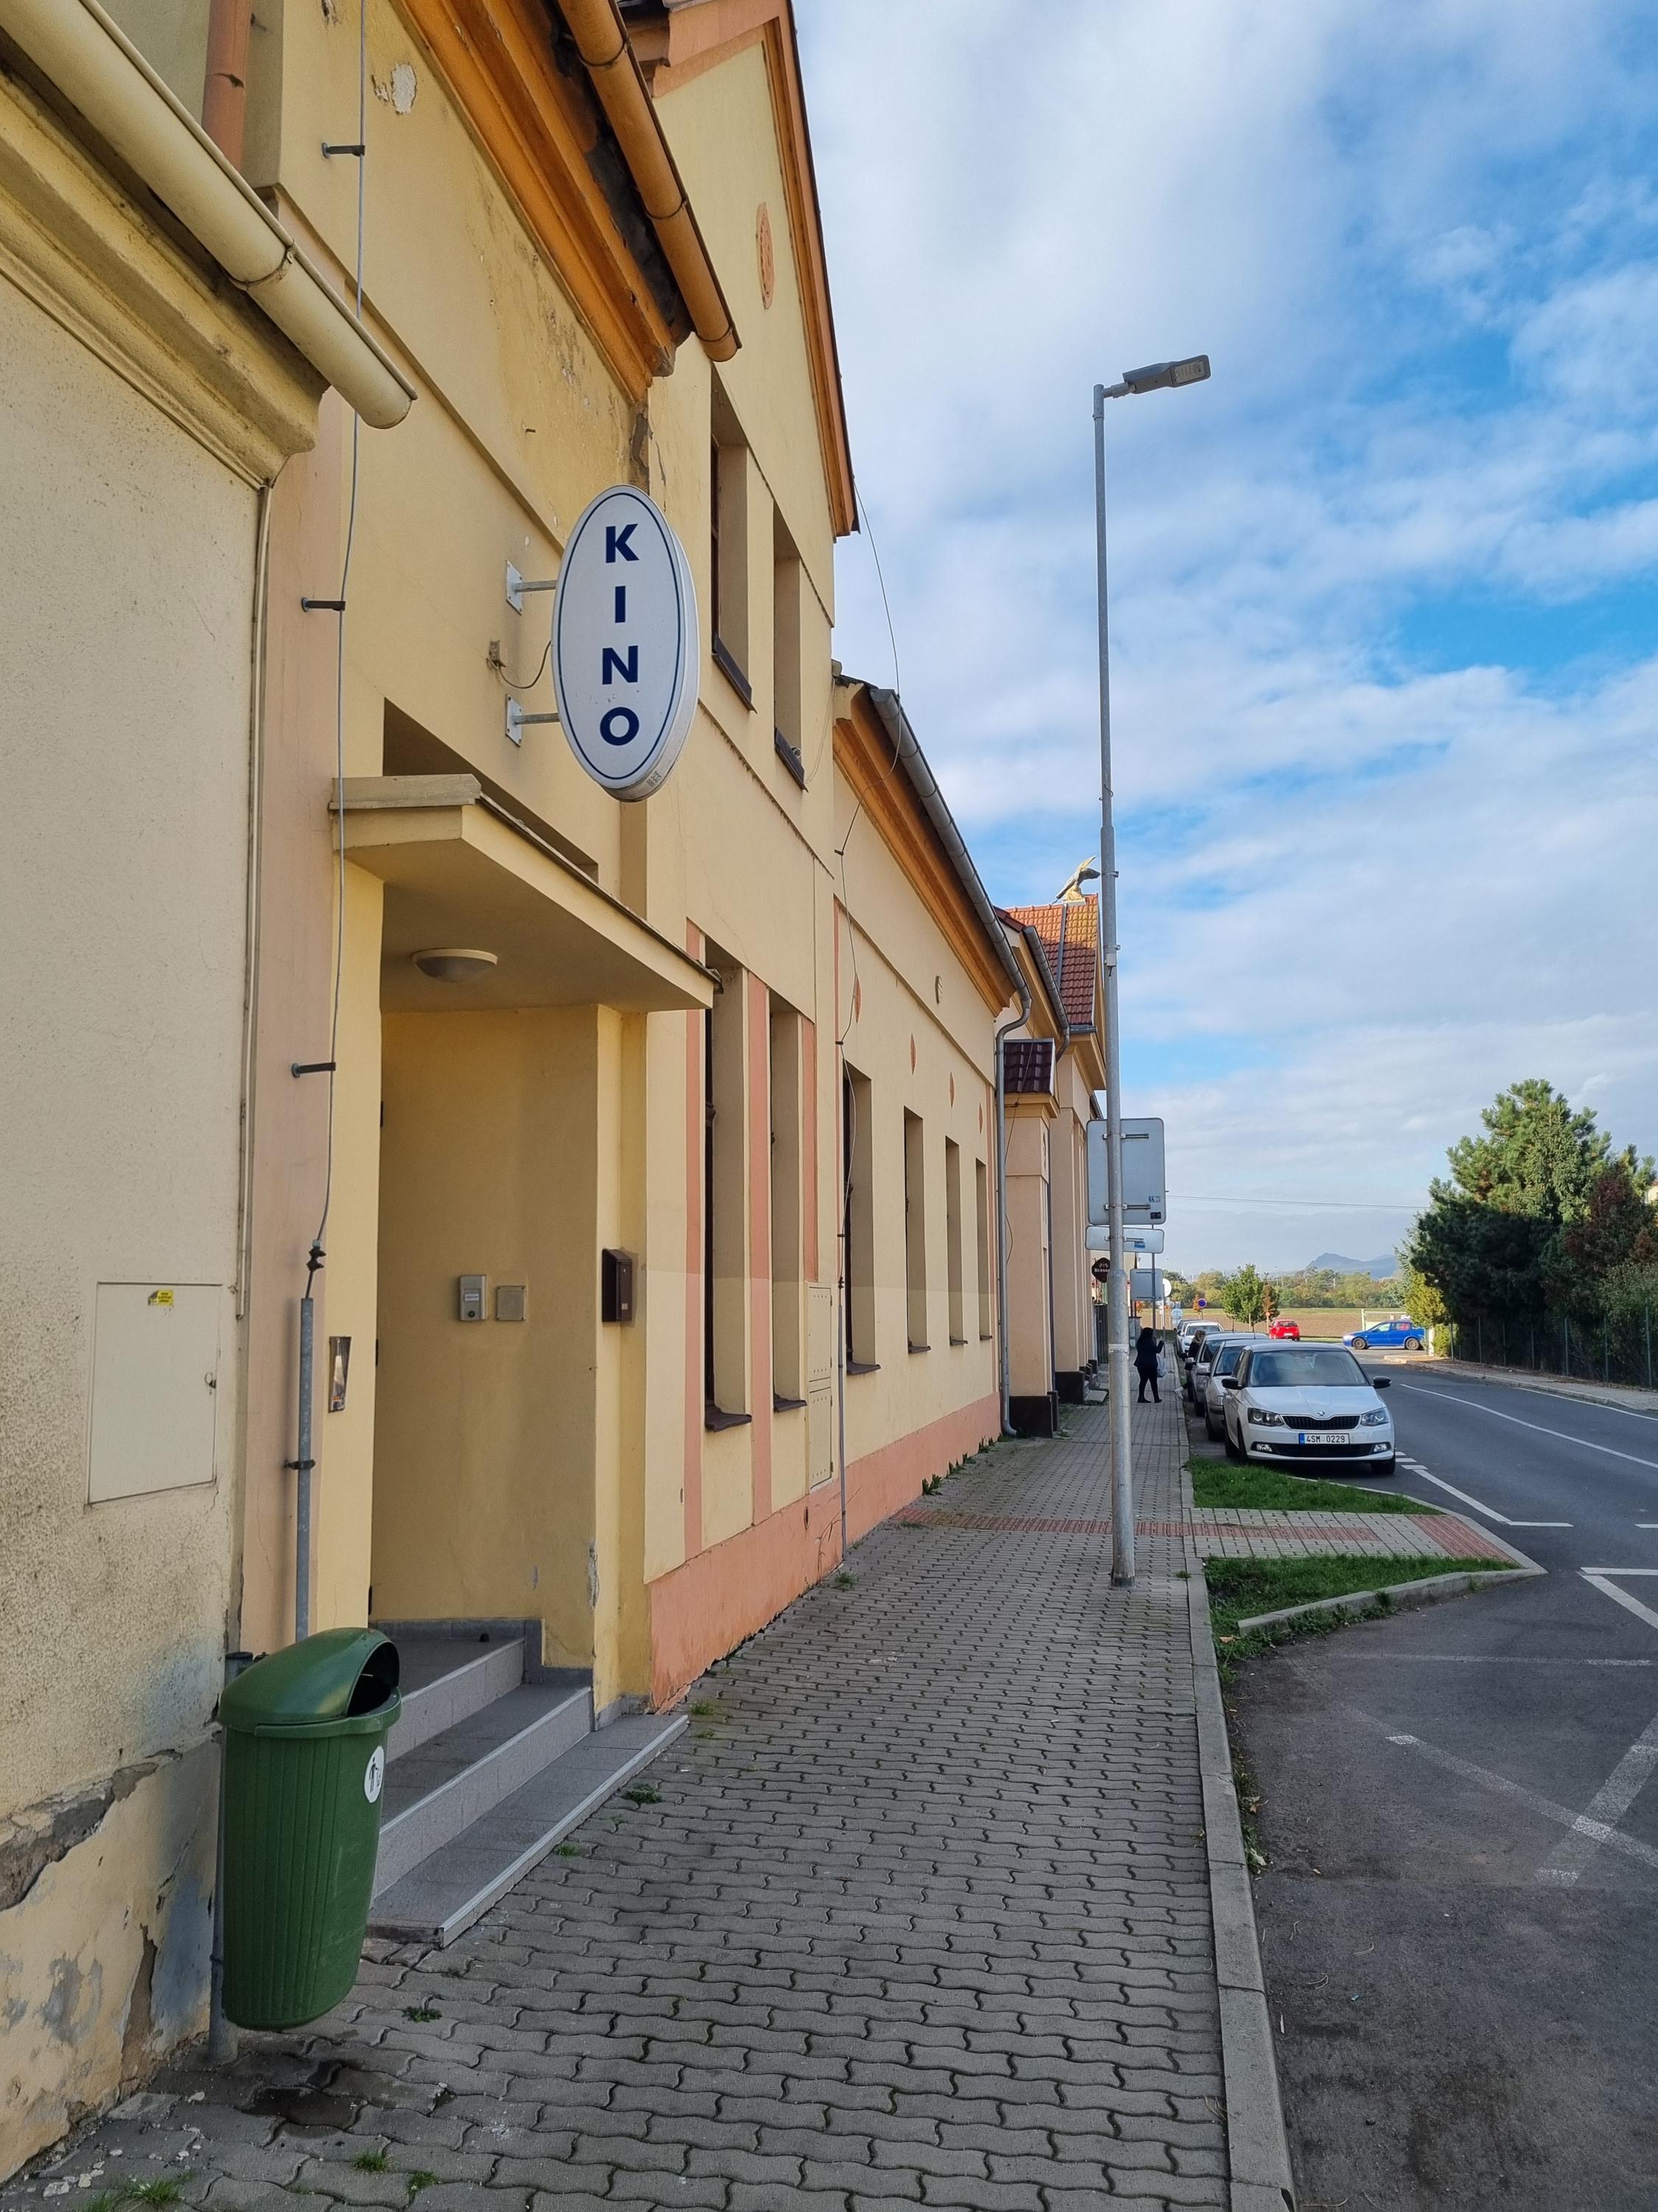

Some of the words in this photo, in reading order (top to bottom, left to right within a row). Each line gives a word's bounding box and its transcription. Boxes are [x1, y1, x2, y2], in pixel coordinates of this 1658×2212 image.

[600, 524, 640, 745] KINO
[1306, 1435, 1321, 1443] 4SM
[1326, 1435, 1345, 1443] 0229
